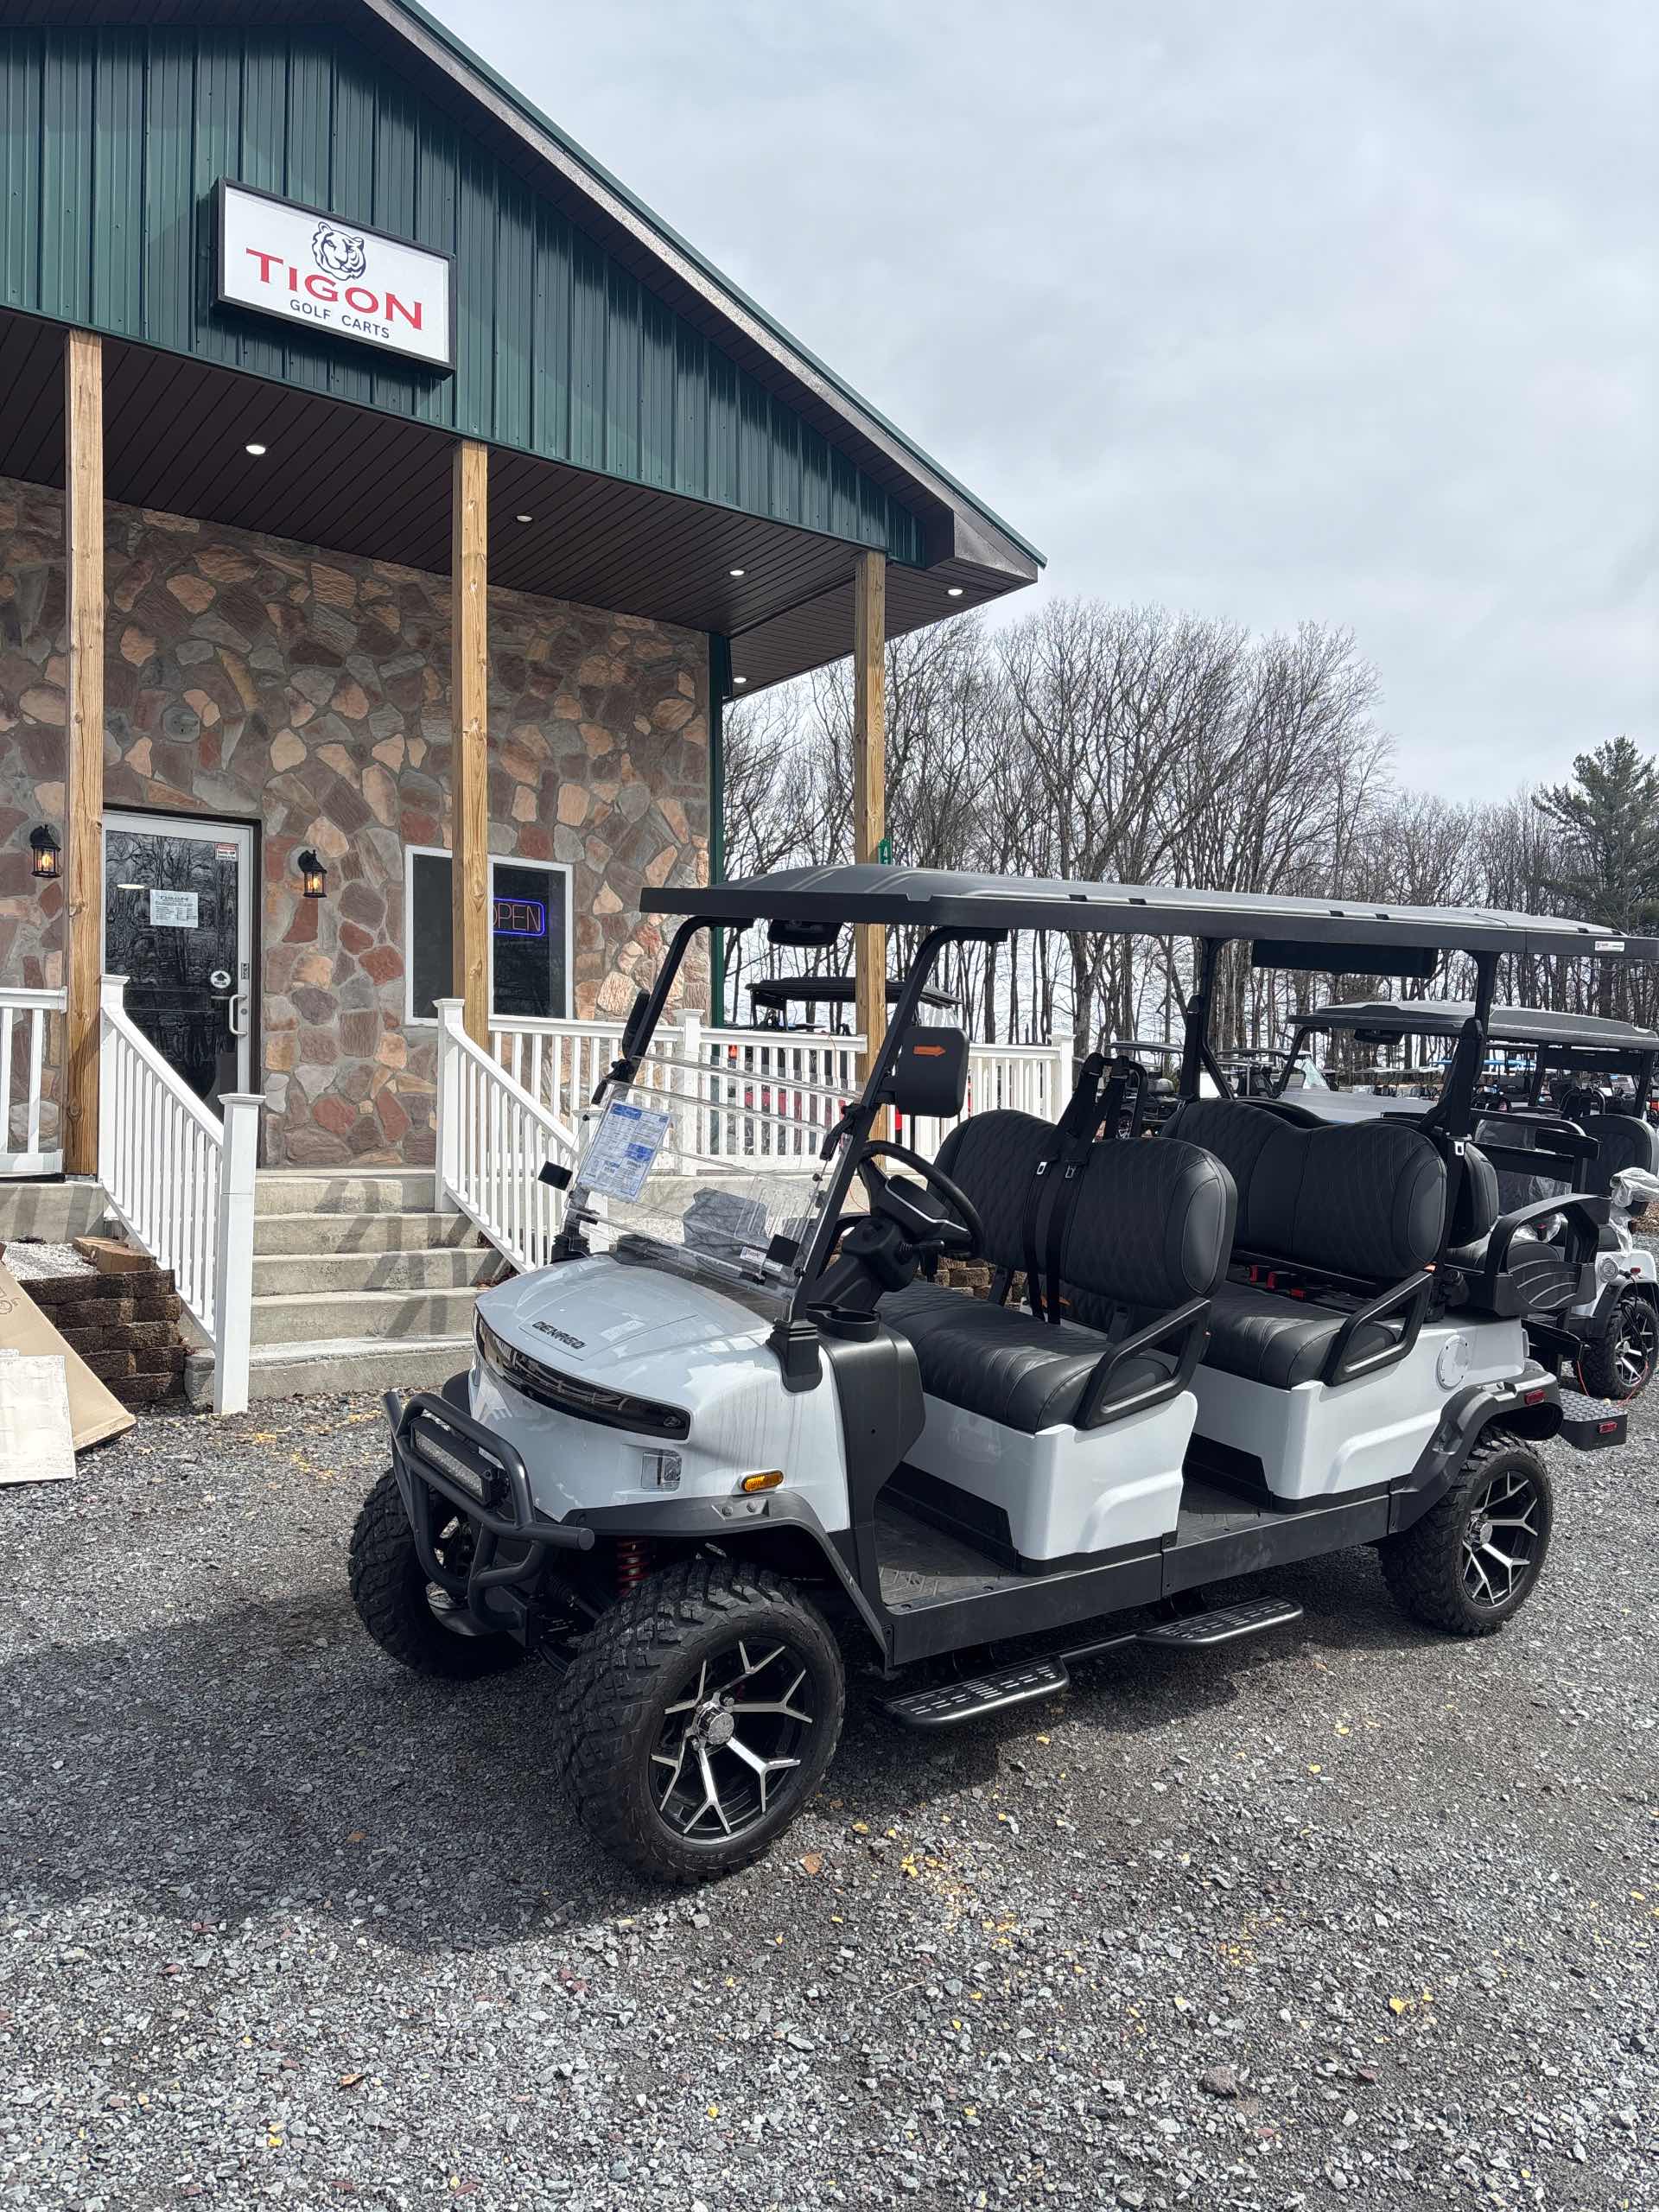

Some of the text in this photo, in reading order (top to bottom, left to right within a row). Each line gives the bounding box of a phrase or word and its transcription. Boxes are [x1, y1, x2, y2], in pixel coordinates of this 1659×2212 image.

[245, 247, 422, 330] TIGON
[289, 299, 390, 339] GOLF CARTS
